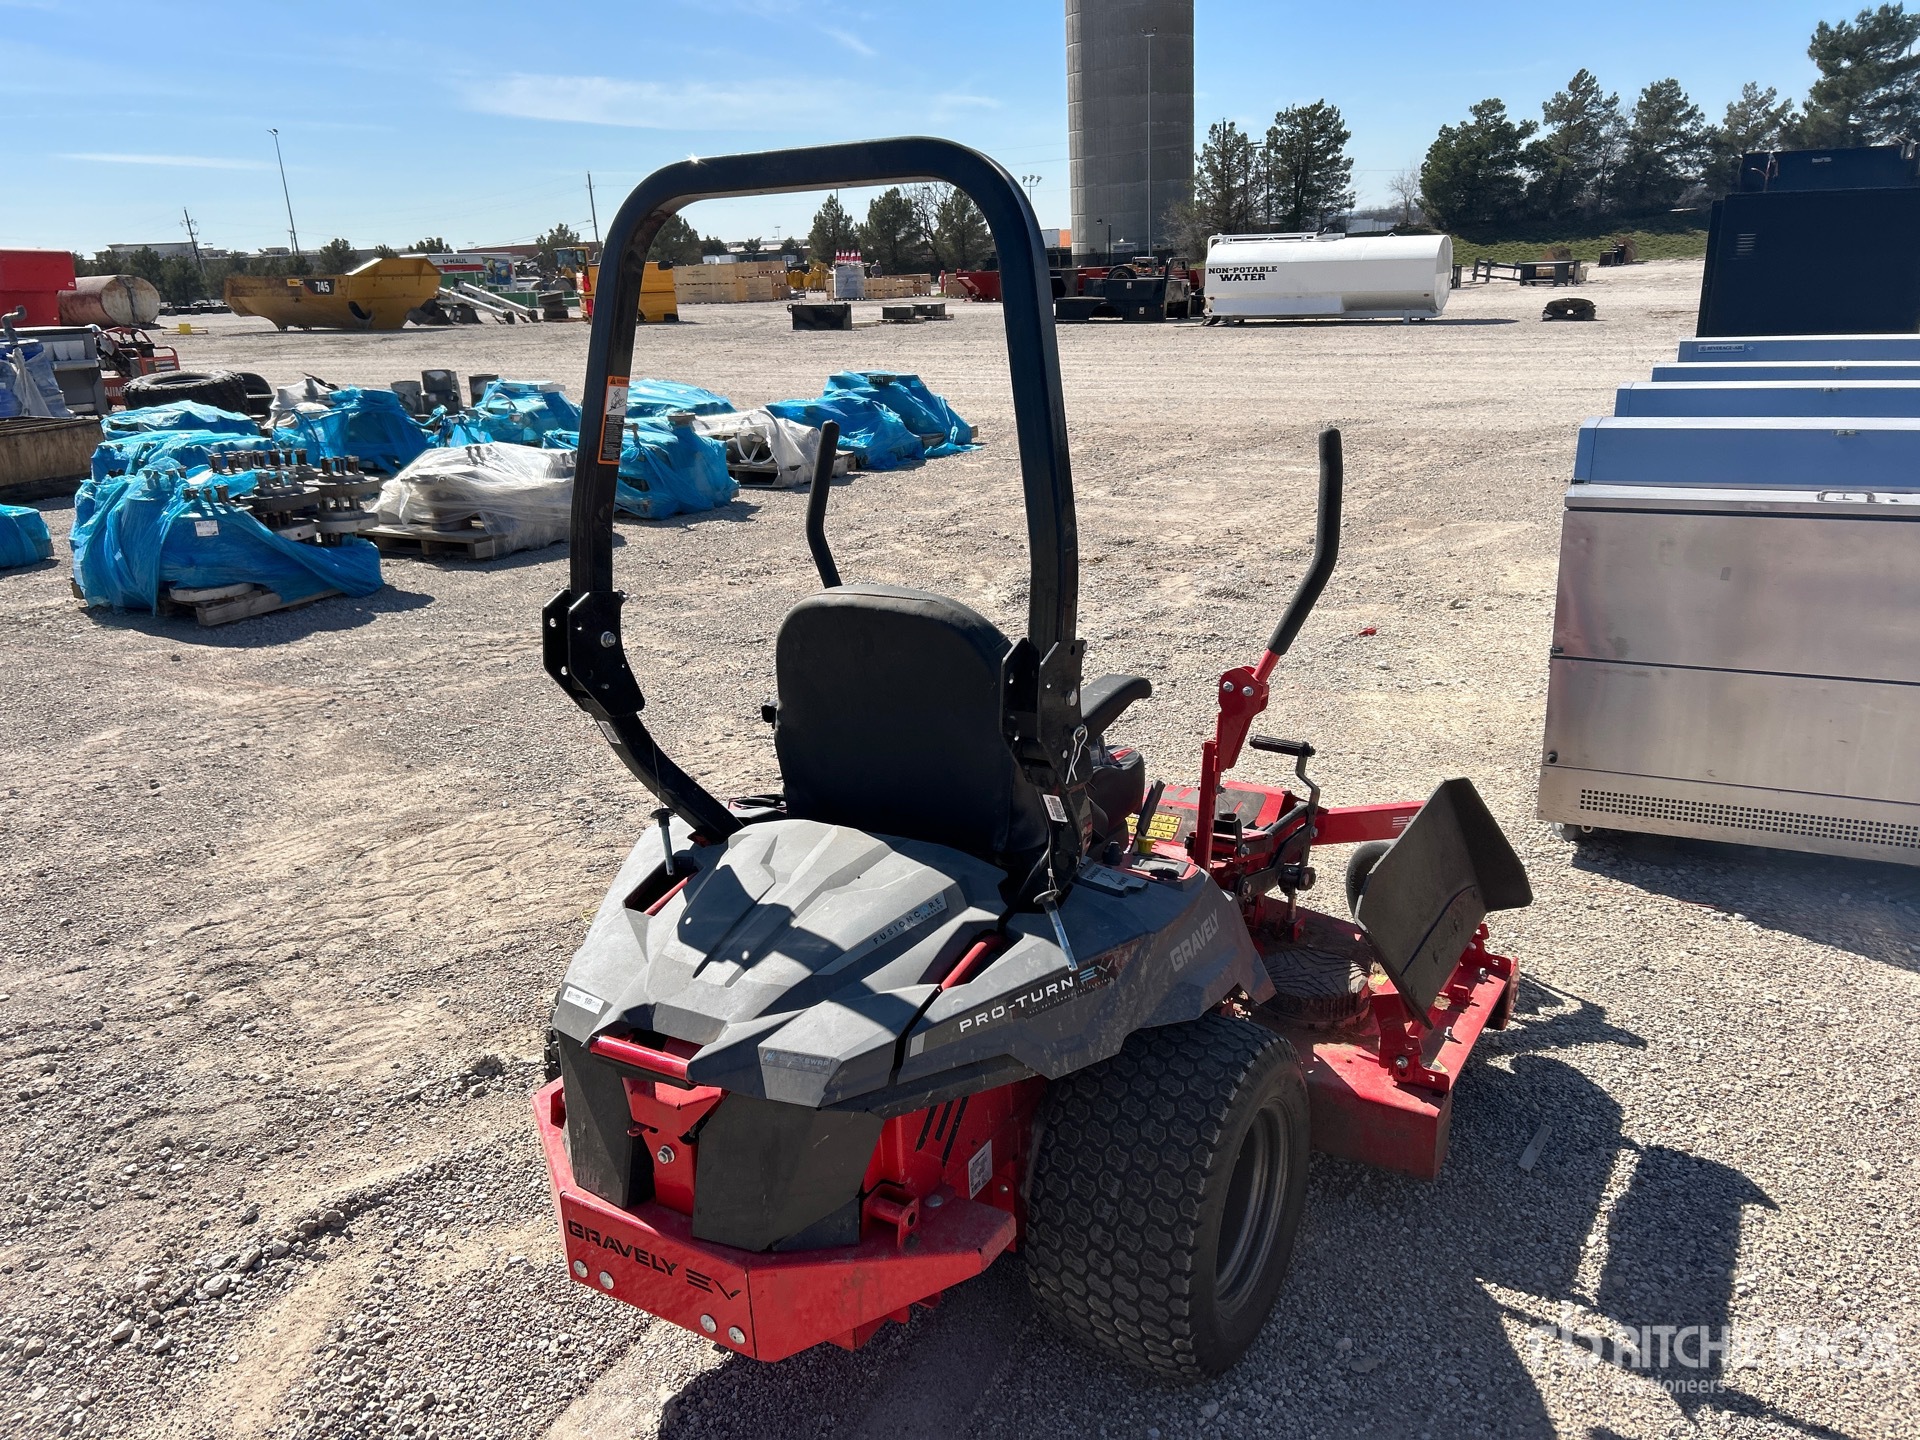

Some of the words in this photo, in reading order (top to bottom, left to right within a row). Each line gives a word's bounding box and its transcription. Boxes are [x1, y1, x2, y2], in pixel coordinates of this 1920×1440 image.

[315, 281, 330, 293] 745
[1208, 266, 1278, 275] NON-POTABLE
[1219, 273, 1266, 282] WATER
[873, 897, 941, 945] FUSIONCORE
[1169, 908, 1220, 973] GRAVELY
[959, 976, 1074, 1033] PRO-TURN
[567, 1219, 678, 1277] GRAVELY
